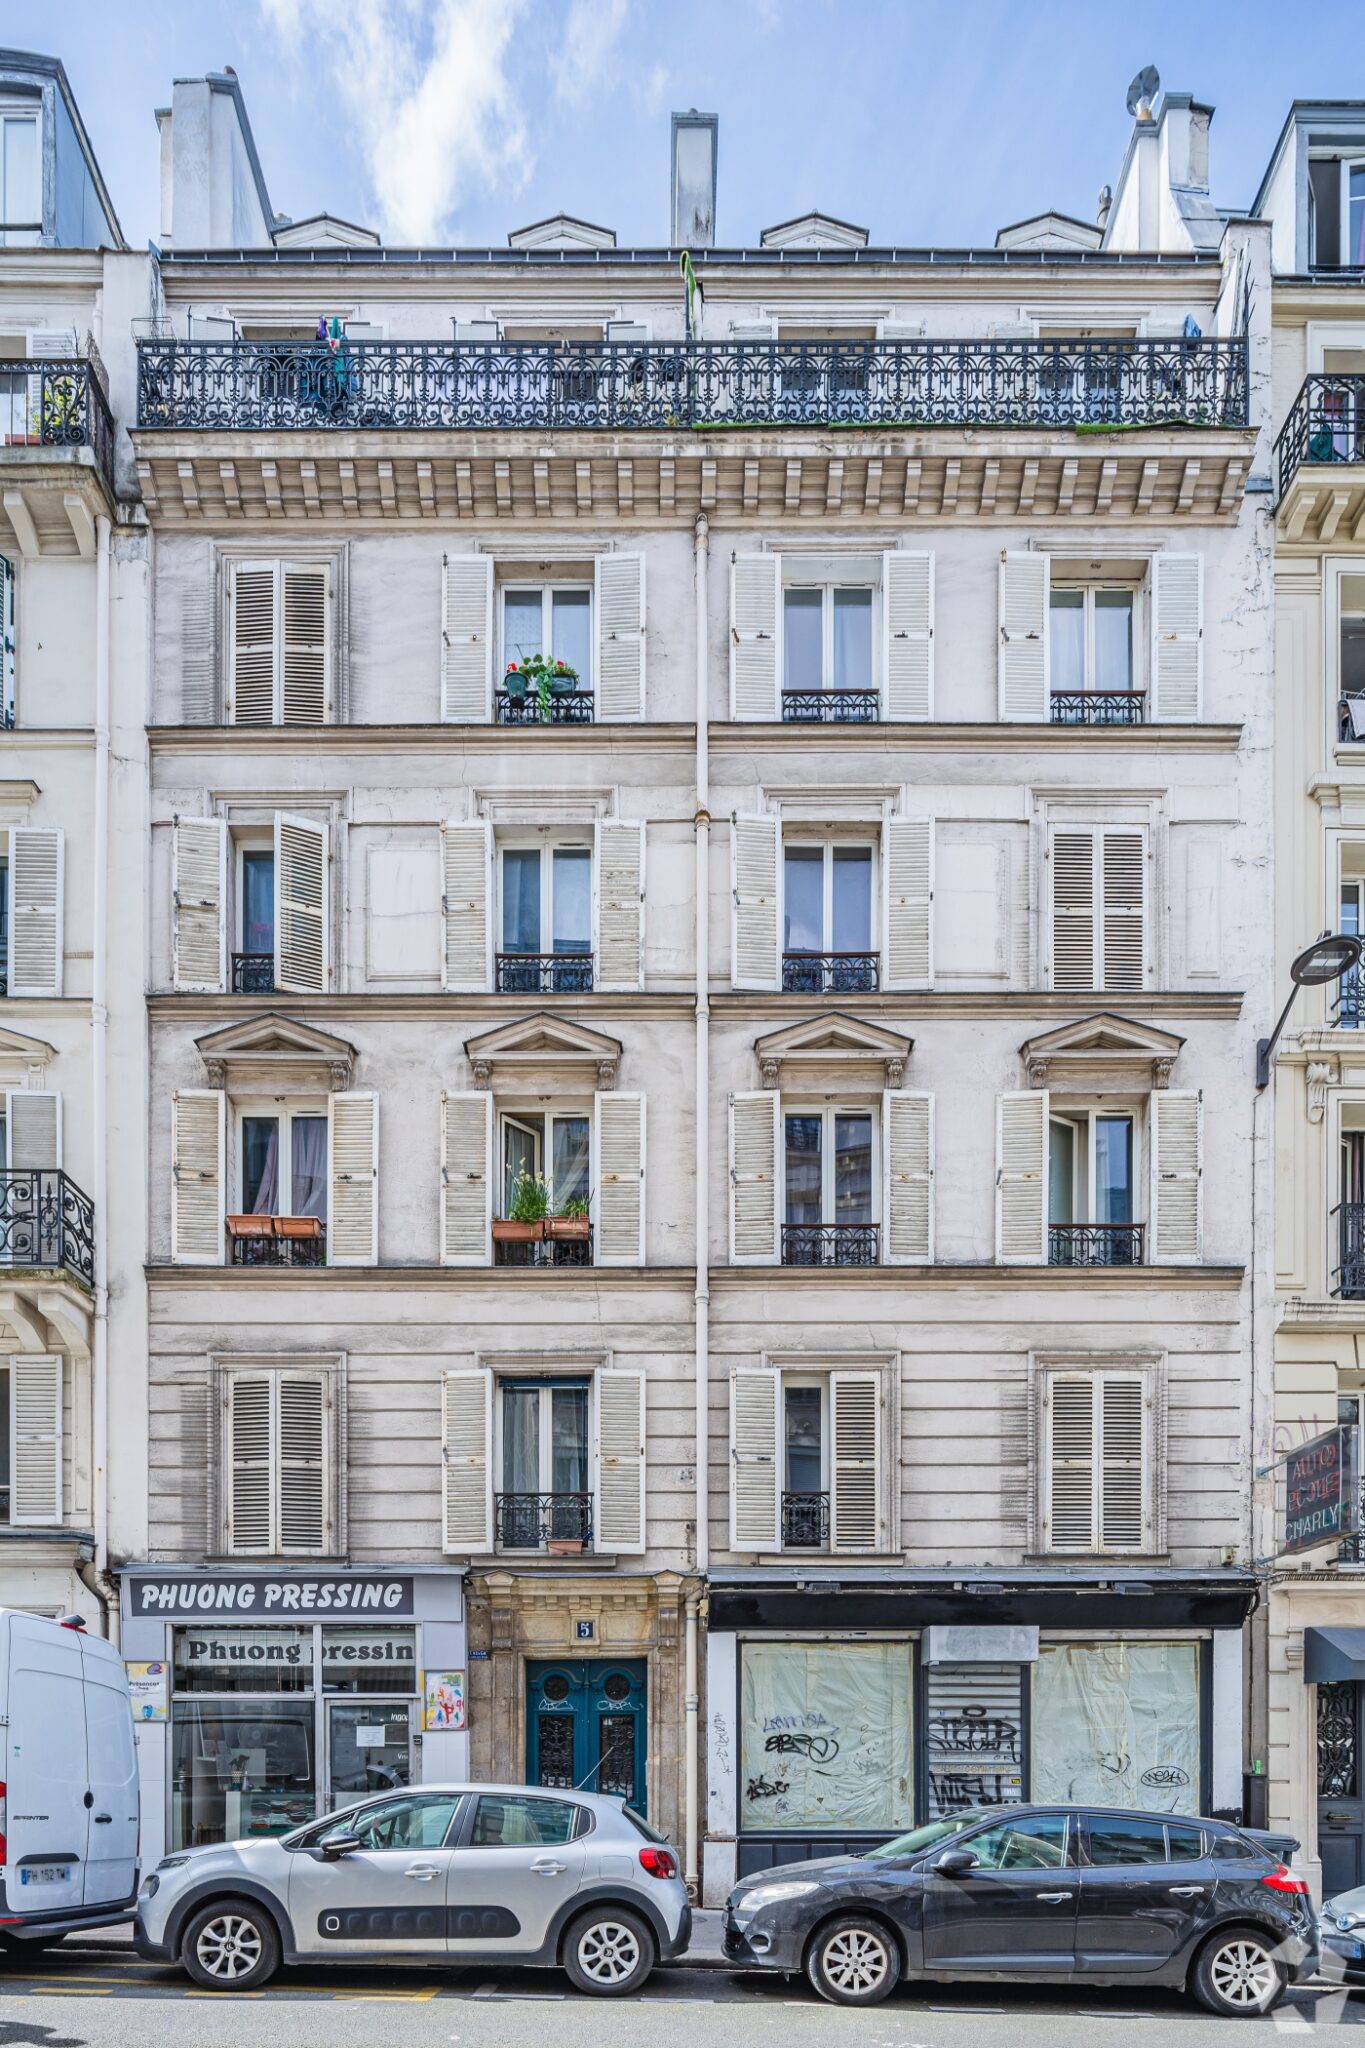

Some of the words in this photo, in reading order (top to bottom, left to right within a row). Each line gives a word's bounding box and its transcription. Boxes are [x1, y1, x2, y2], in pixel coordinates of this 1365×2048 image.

[1285, 1503, 1340, 1543] CHARLY
[141, 1583, 256, 1609] PHUONG
[264, 1583, 403, 1610] PRESSING
[580, 1622, 590, 1637] 5
[188, 1640, 301, 1664] Phuong
